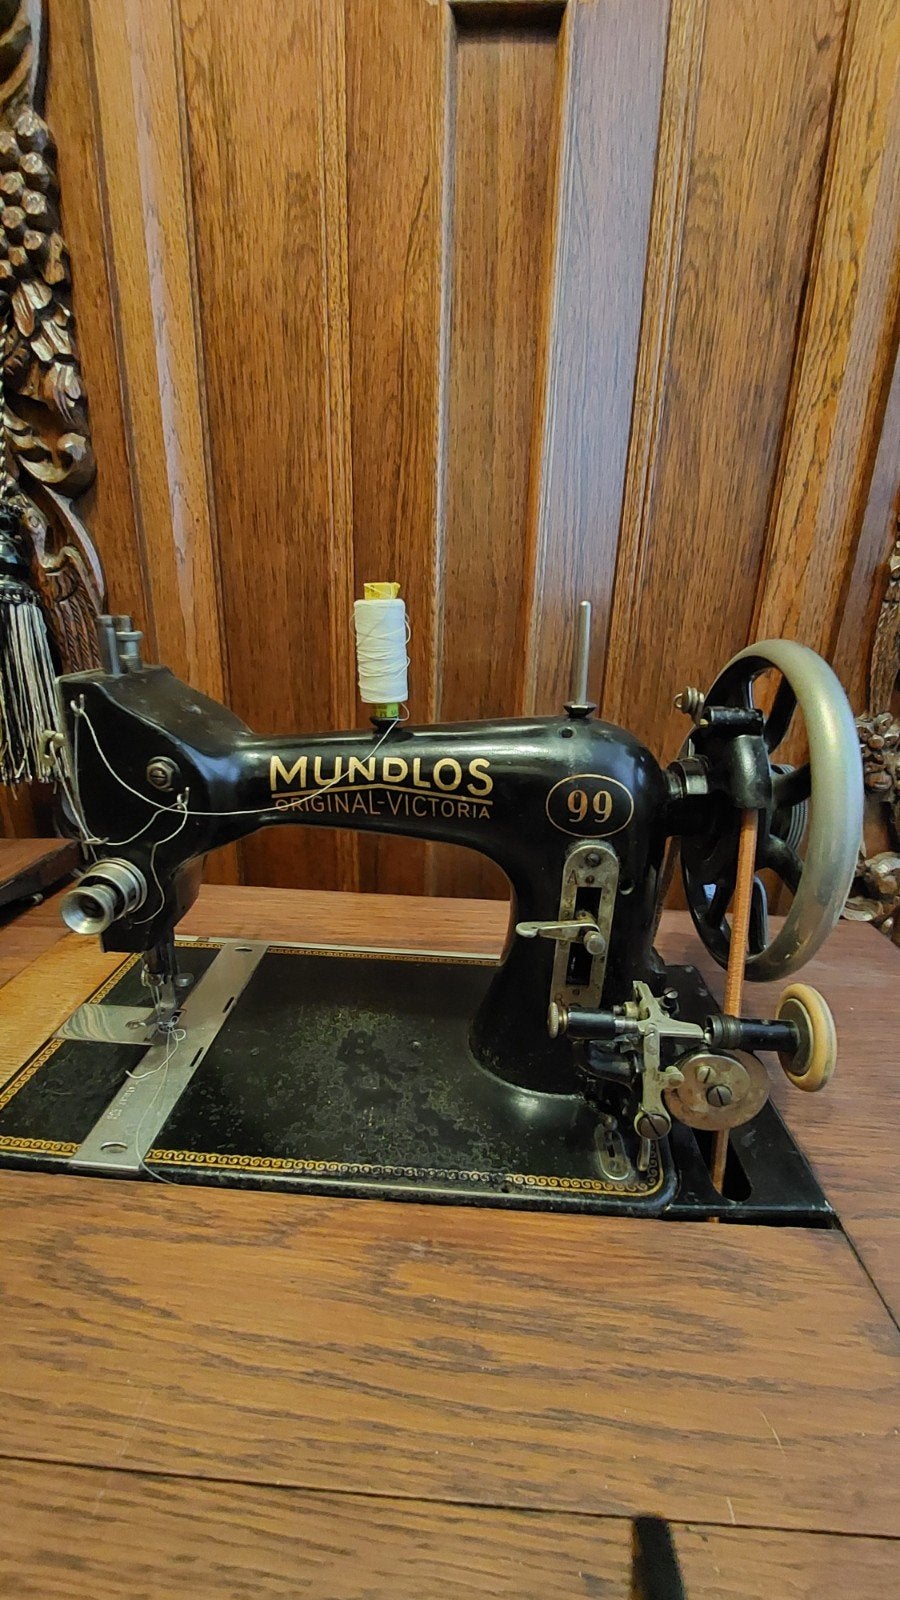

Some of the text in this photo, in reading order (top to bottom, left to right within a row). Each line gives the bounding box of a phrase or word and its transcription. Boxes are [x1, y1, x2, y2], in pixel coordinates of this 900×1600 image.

[270, 755, 493, 796] MUNDLOS
[275, 789, 491, 819] ORIGINAL-VICTORIA
[566, 789, 613, 823] 99
[567, 869, 578, 885] A
